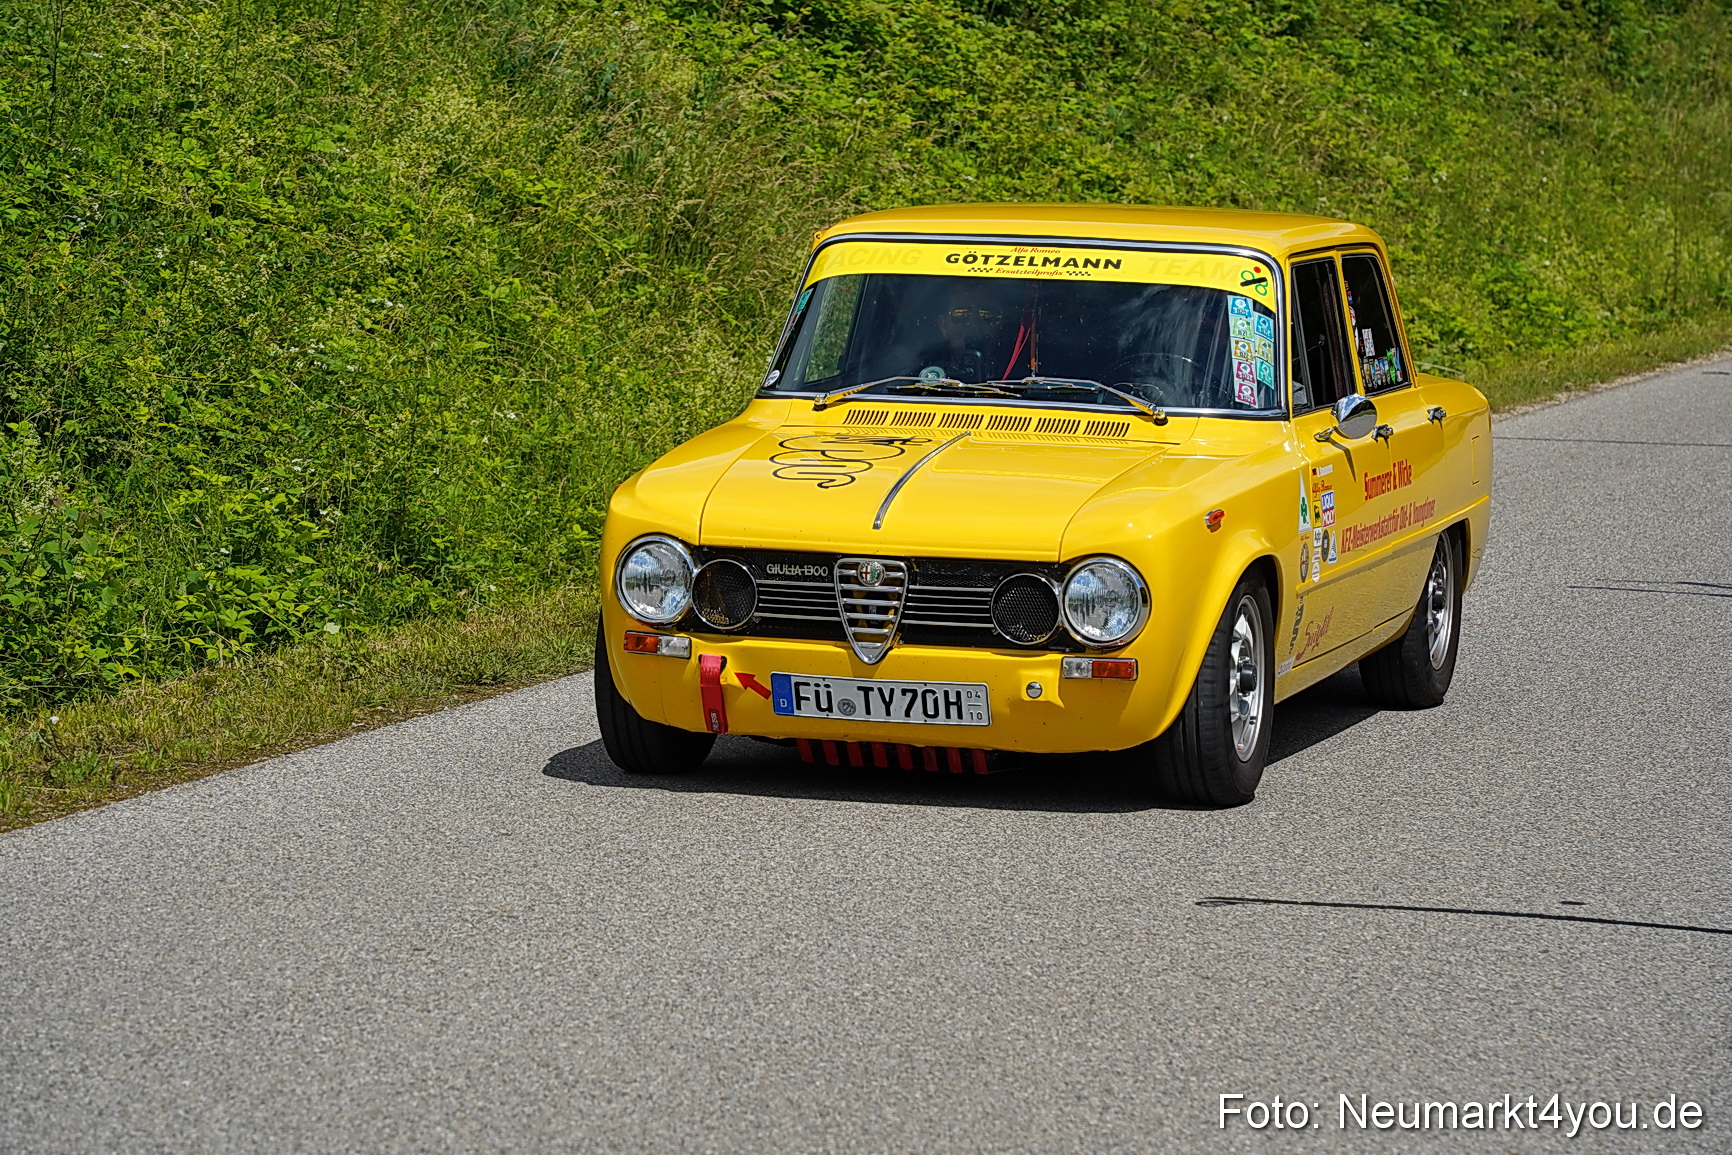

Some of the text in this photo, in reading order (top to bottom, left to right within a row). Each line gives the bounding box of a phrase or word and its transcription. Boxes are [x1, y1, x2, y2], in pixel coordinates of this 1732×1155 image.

[945, 250, 1122, 270] GÖTZELMANN
[995, 267, 1063, 277] Ersatzteilprofis
[1146, 256, 1243, 284] TEAM
[1363, 471, 1392, 501] Summerer
[1392, 462, 1397, 491] &
[766, 563, 829, 577] GIULIA 1300
[793, 680, 834, 713] FÜ
[966, 690, 982, 699] 04
[968, 709, 983, 721] 10
